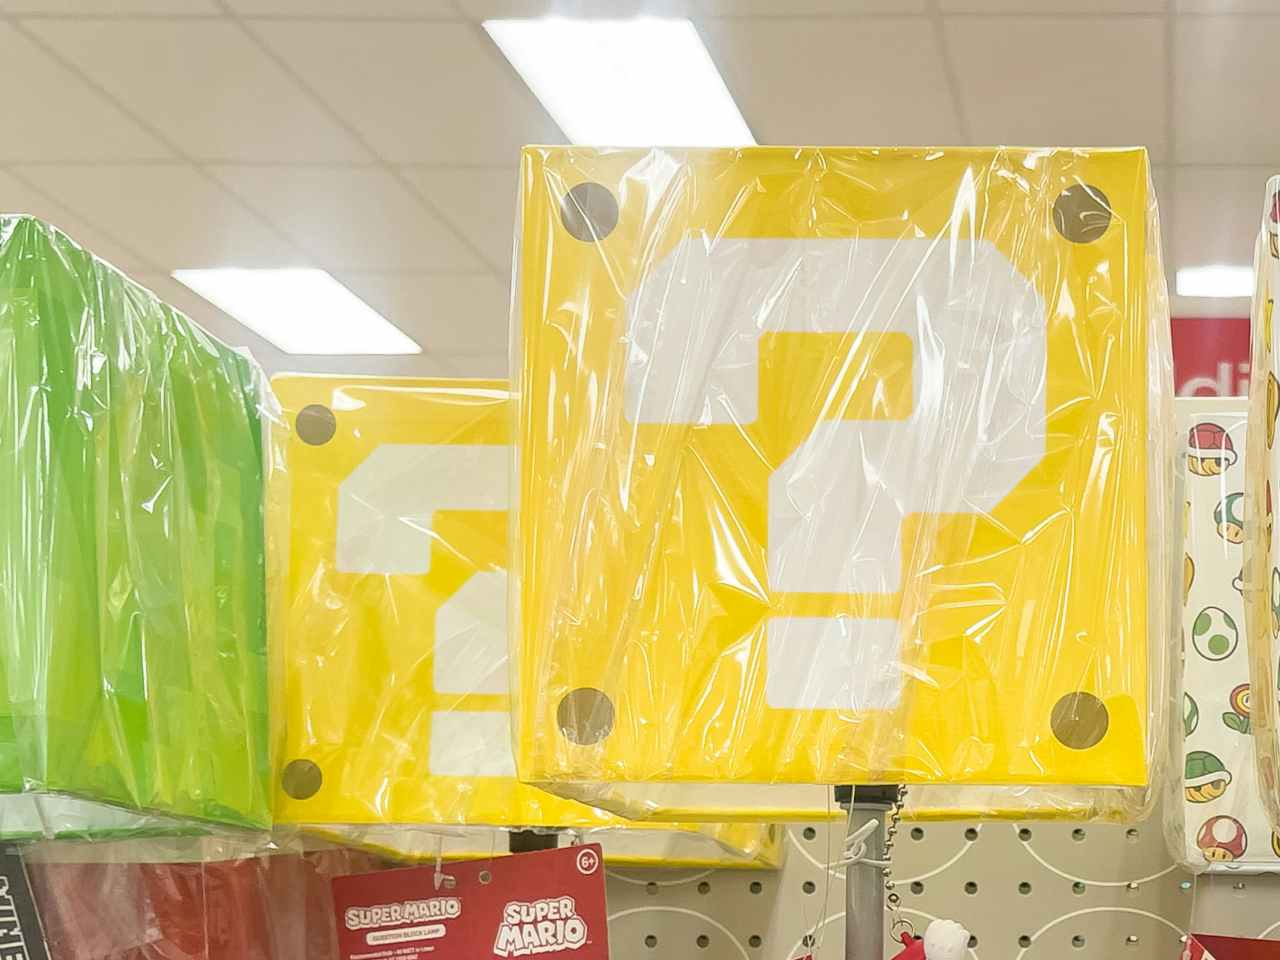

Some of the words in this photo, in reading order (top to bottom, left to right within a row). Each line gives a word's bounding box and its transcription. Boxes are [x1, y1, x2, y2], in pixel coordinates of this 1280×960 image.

[345, 903, 402, 930] SUPER
[402, 897, 462, 923] MARIO
[503, 896, 576, 925] SUPER
[494, 914, 589, 958] MARIO
